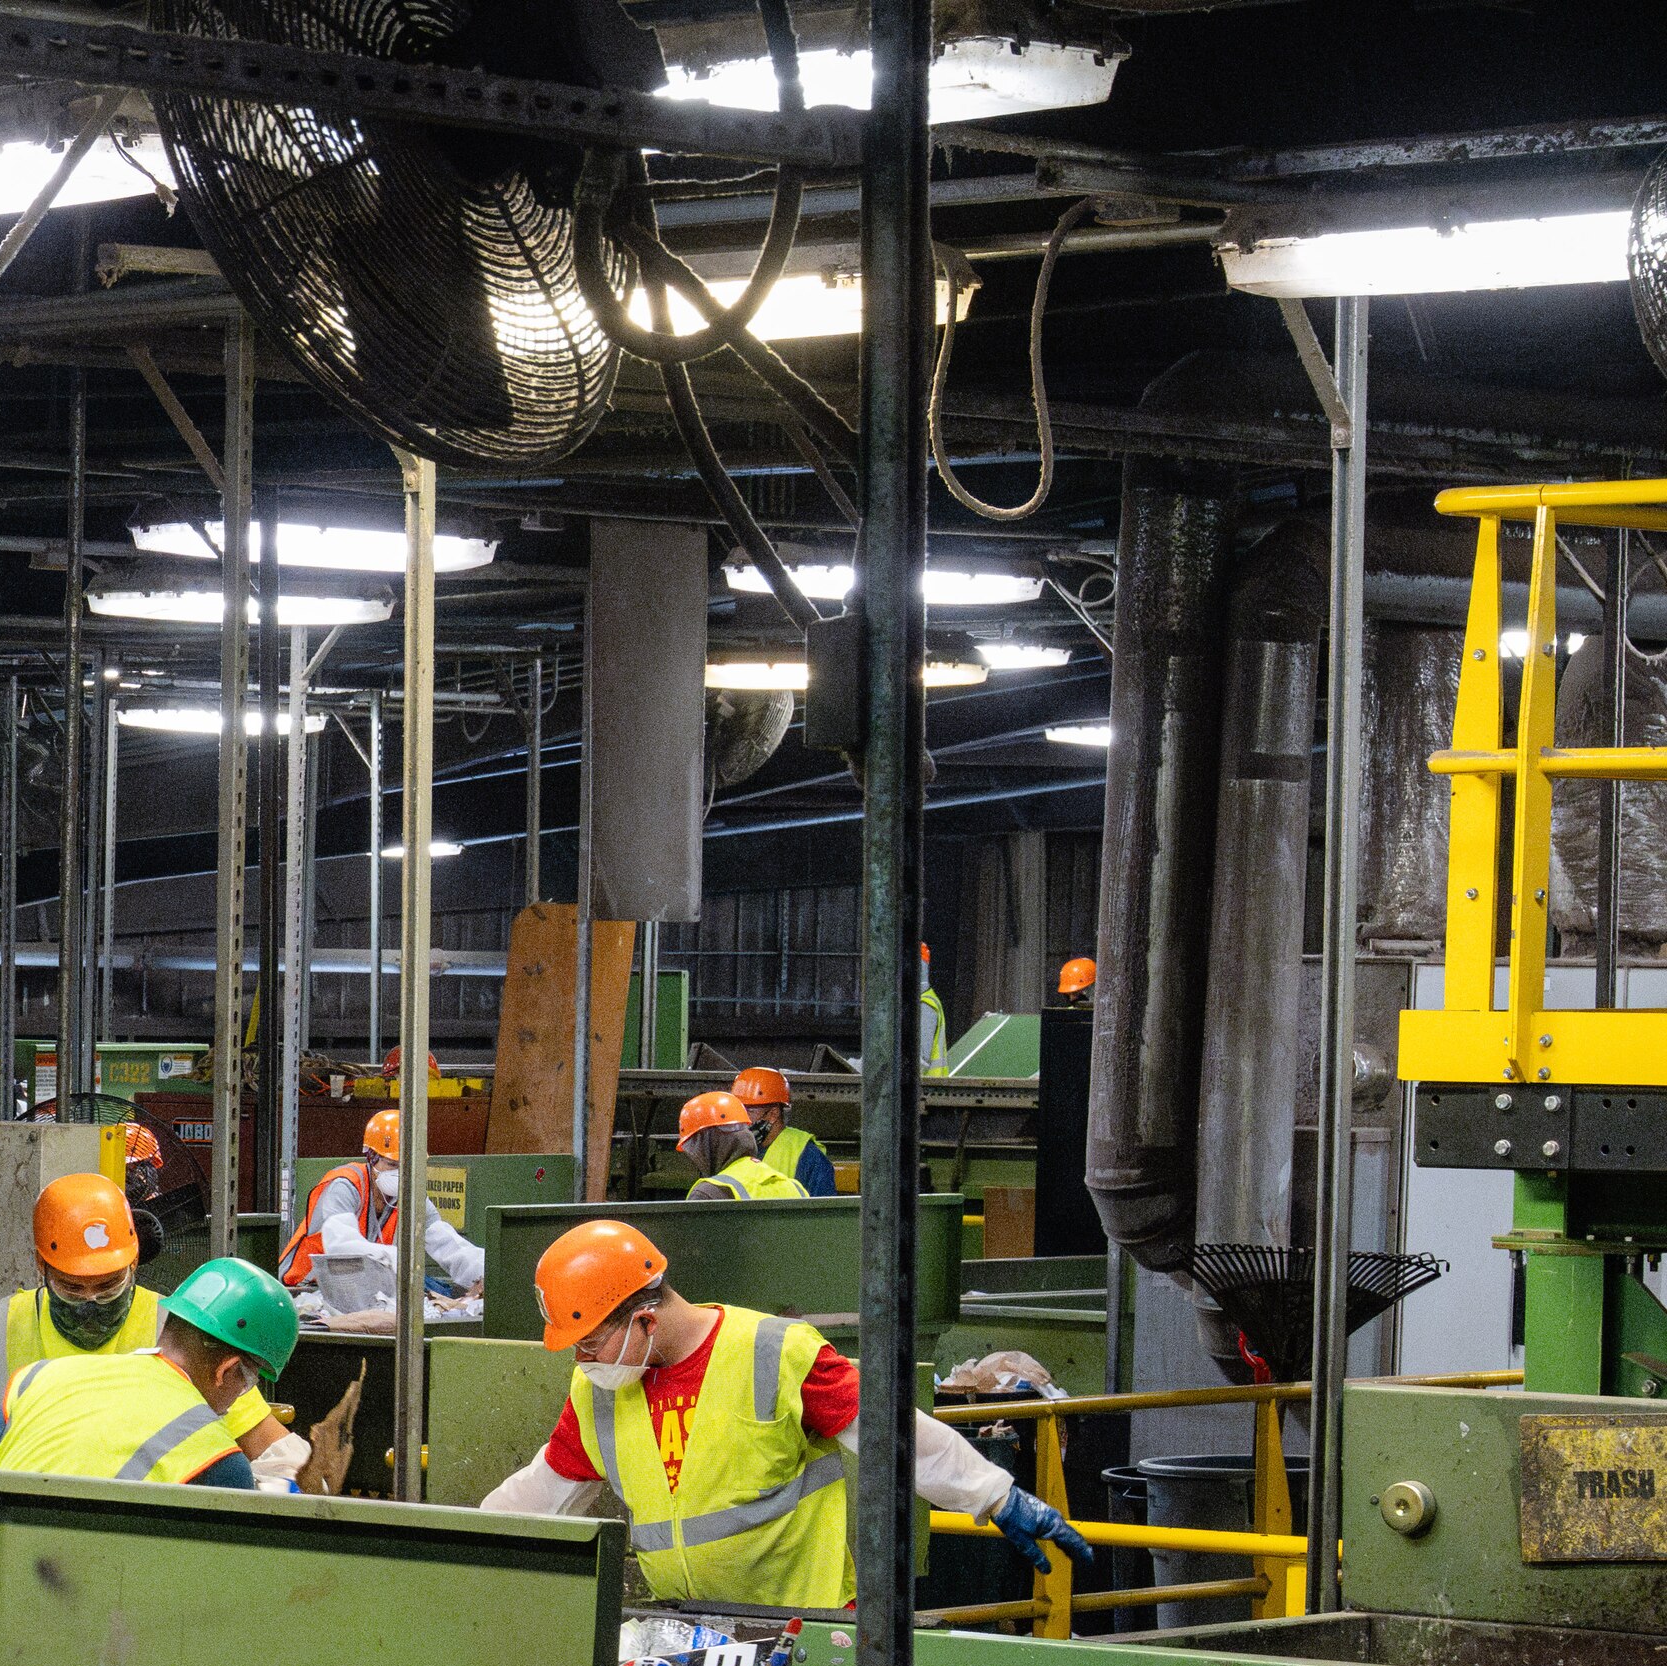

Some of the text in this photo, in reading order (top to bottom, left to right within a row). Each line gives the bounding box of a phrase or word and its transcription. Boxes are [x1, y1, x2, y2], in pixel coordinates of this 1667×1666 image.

[175, 1123, 213, 1140] JOBO
[443, 1181, 464, 1193] PAPER
[439, 1197, 461, 1210] BOOKS
[1573, 1469, 1655, 1499] TRASH
